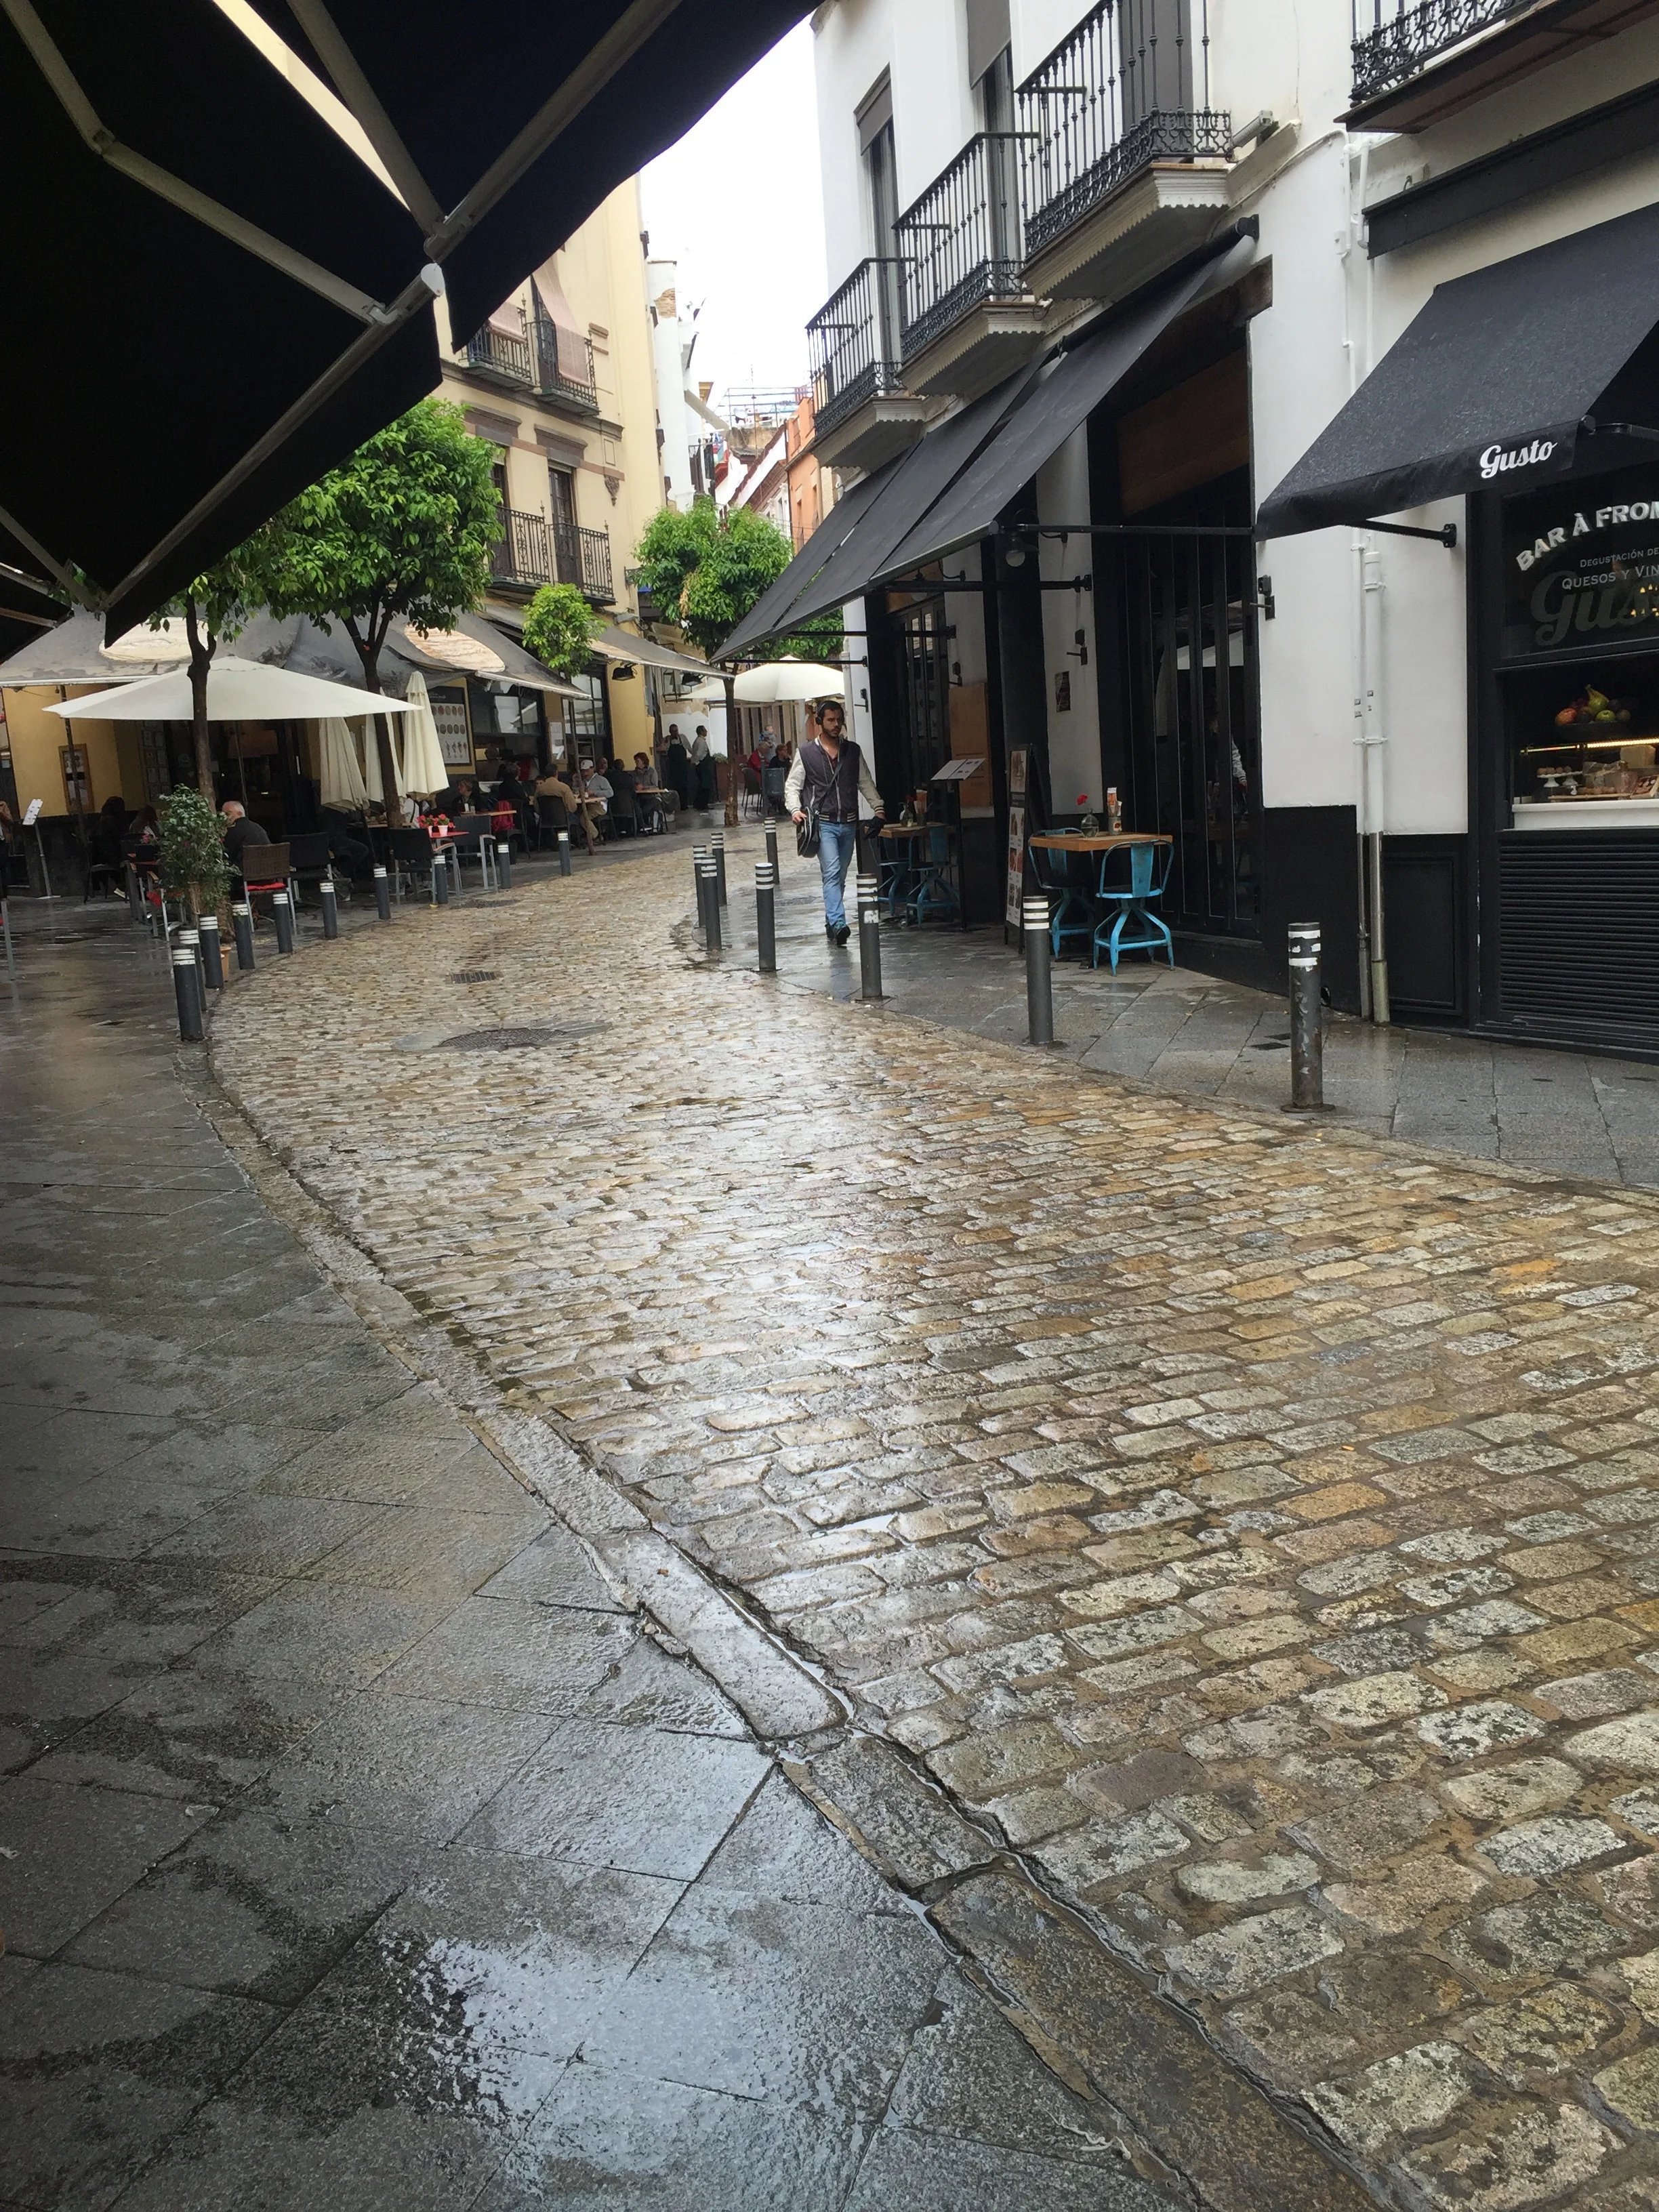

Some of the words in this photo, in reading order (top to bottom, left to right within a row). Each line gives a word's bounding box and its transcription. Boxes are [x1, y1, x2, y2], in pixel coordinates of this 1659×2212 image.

[1479, 440, 1557, 478] Gusto
[1516, 527, 1566, 571] BAR
[1580, 549, 1644, 568] DEGUSTACIÓN
[1562, 572, 1616, 590] QUESOS
[1621, 569, 1629, 579] Y
[1531, 570, 1659, 646] Gus
